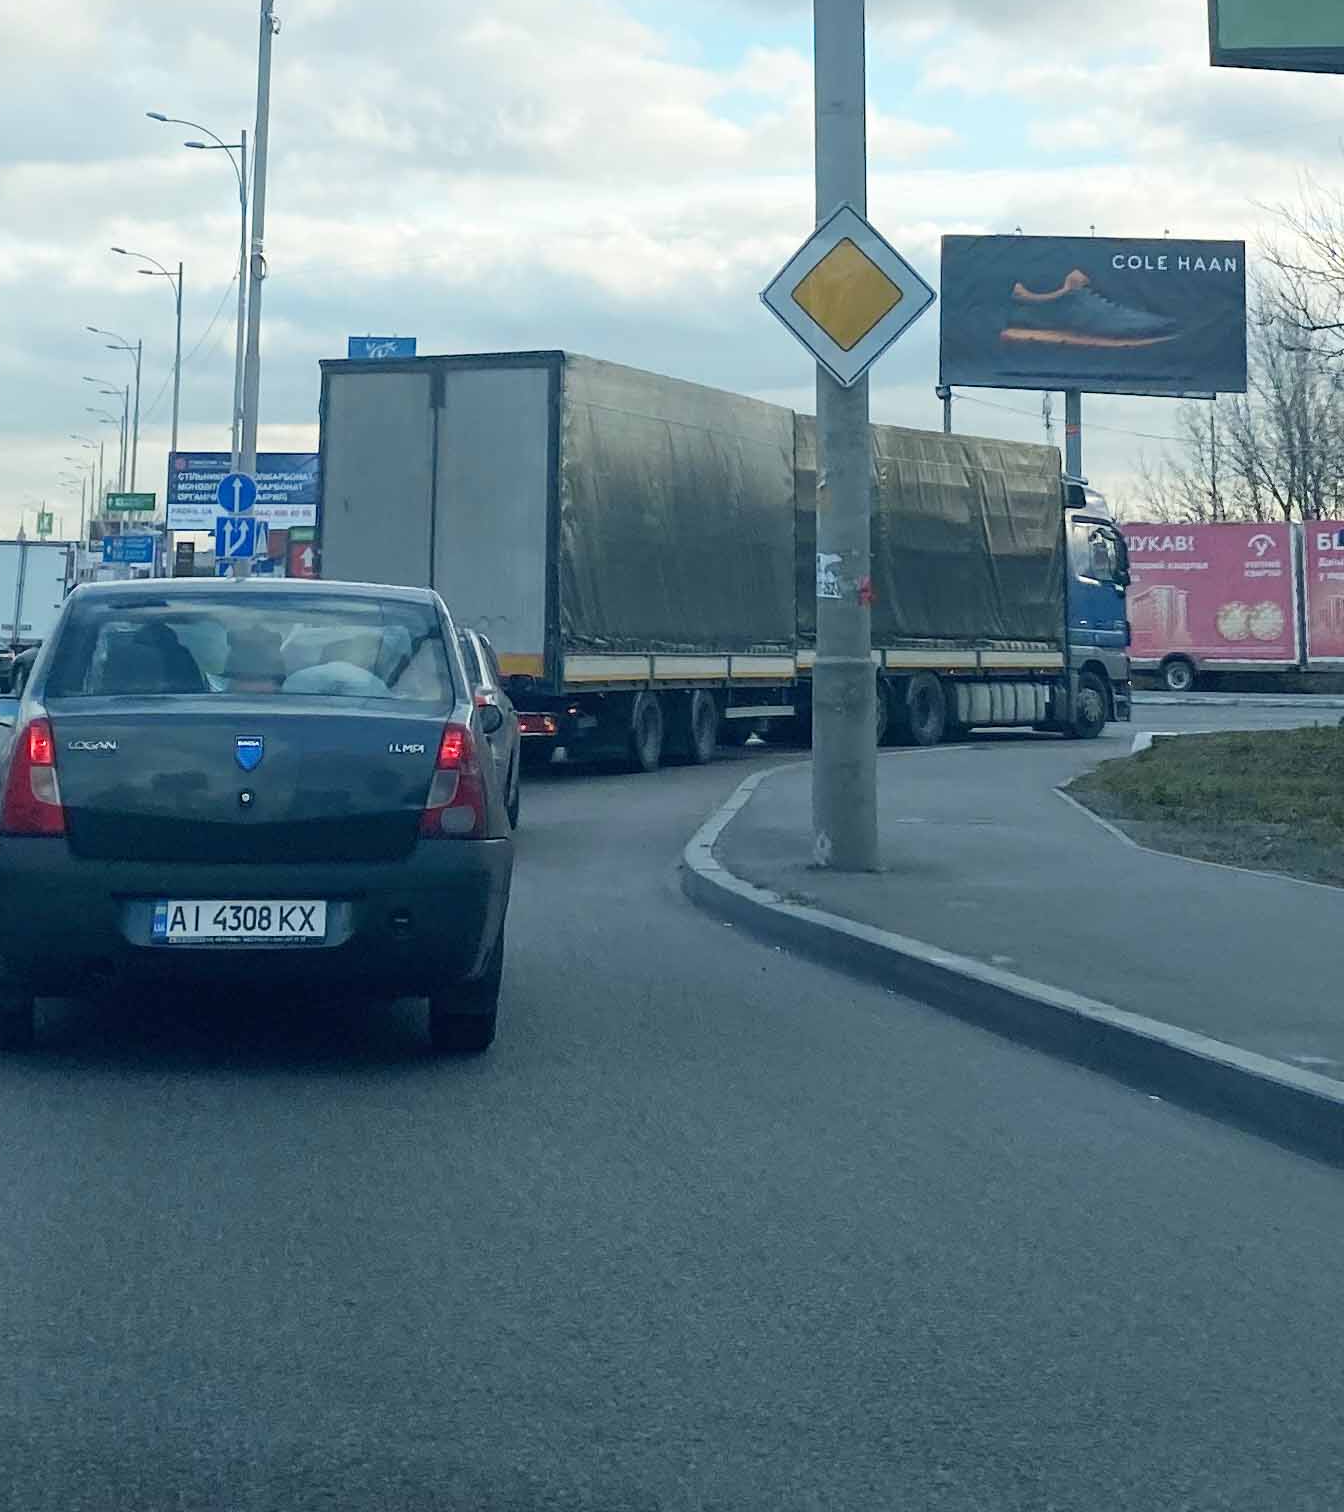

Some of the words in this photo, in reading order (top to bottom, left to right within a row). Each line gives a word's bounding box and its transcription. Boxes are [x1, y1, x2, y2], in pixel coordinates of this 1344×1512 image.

[1111, 254, 1169, 271] COLE
[1177, 256, 1238, 273] HAAN
[169, 905, 201, 932] AI
[212, 905, 272, 932] 4308
[278, 905, 316, 932] KX
